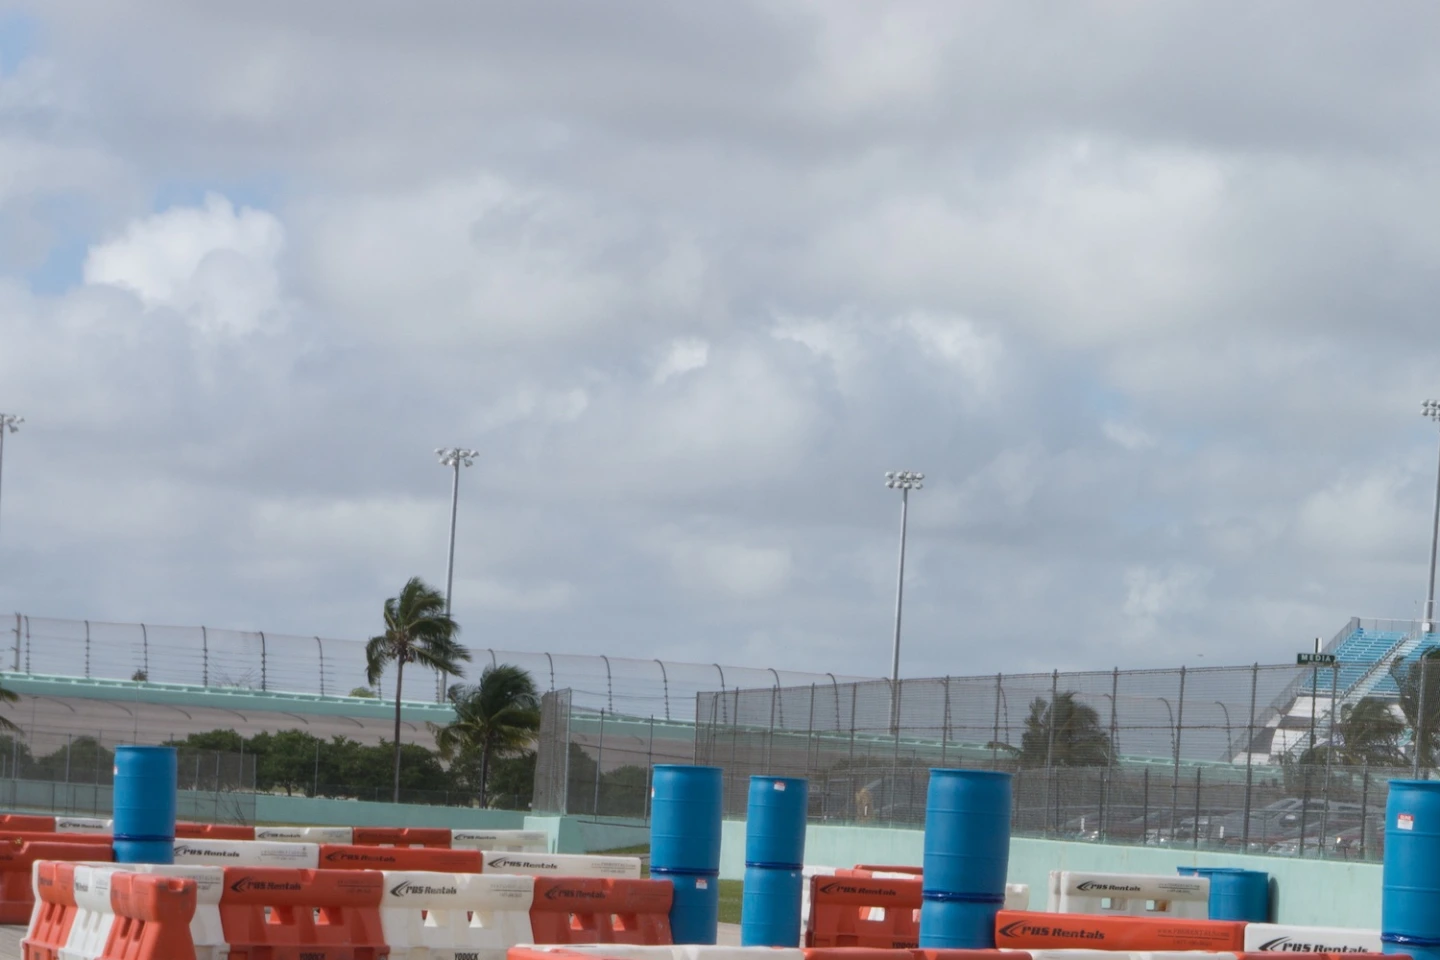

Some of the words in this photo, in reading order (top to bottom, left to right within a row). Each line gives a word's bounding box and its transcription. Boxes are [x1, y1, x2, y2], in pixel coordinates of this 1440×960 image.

[1301, 654, 1331, 662] MEDIA
[203, 850, 240, 858] Rentals
[503, 860, 522, 868] PBS
[522, 861, 558, 870] Rentals
[406, 886, 424, 895] PBS
[424, 886, 457, 895] Rentals
[858, 888, 897, 896] Rentals
[1090, 883, 1108, 891] PBS
[1108, 884, 1141, 892] Rentals
[1021, 926, 1050, 937] PBS
[1051, 927, 1105, 940] Rentals
[1281, 942, 1312, 953] PBS
[454, 952, 479, 960] YODOCK
